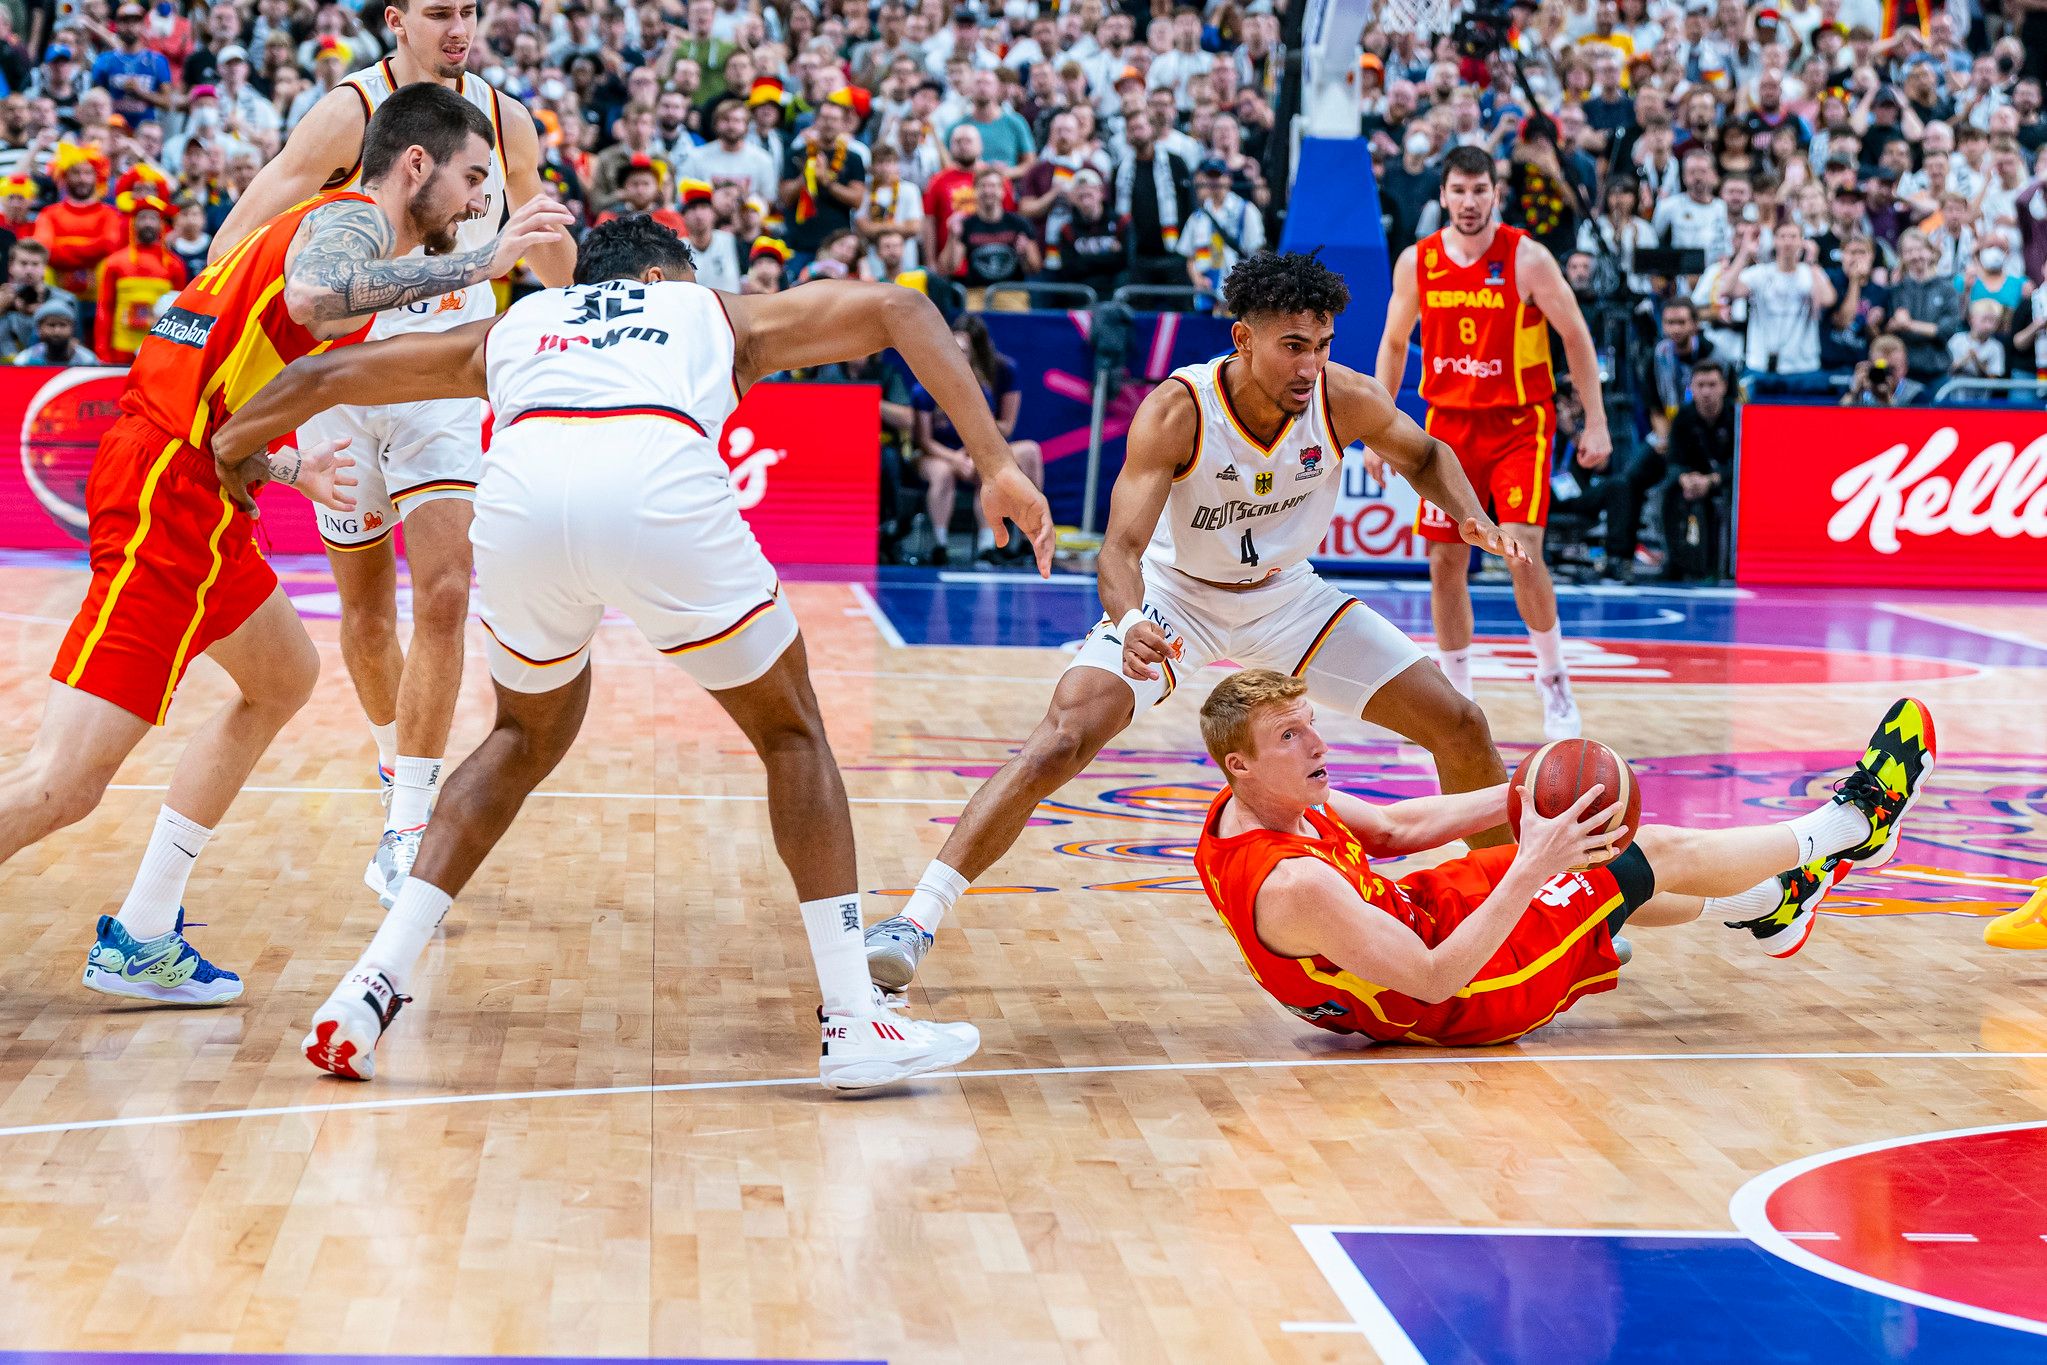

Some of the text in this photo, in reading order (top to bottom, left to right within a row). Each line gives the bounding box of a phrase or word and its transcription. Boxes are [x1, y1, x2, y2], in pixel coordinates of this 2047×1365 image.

[1426, 288, 1505, 310] ESPAÑA
[1458, 317, 1477, 345] 8
[1433, 354, 1502, 378] endesa
[324, 513, 358, 534] ING
[1240, 528, 1259, 567] 4
[839, 902, 860, 933] PEAK
[822, 1027, 848, 1039] IME
